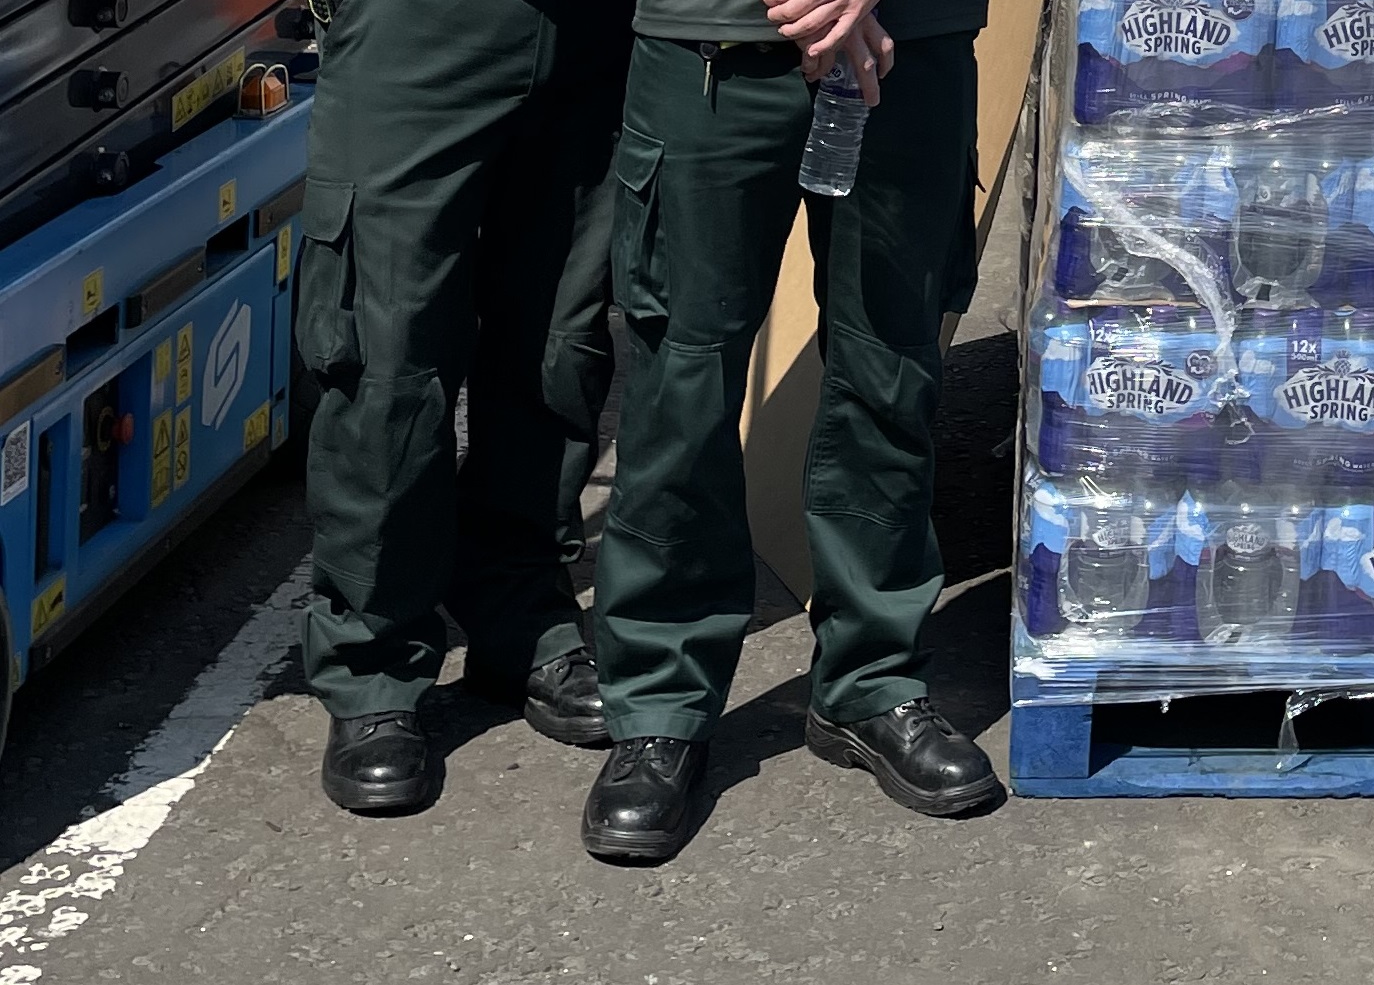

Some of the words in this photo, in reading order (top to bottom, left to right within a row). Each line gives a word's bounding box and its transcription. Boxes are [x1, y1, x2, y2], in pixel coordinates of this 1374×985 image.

[1121, 12, 1231, 46] HIGHLAND
[1143, 35, 1202, 55] SPRING
[1151, 91, 1187, 102] SPRING
[1291, 340, 1317, 353] 12x
[1087, 368, 1193, 405] HIGHLAND
[1107, 393, 1164, 414] SPRING
[1309, 400, 1368, 422] SPRING
